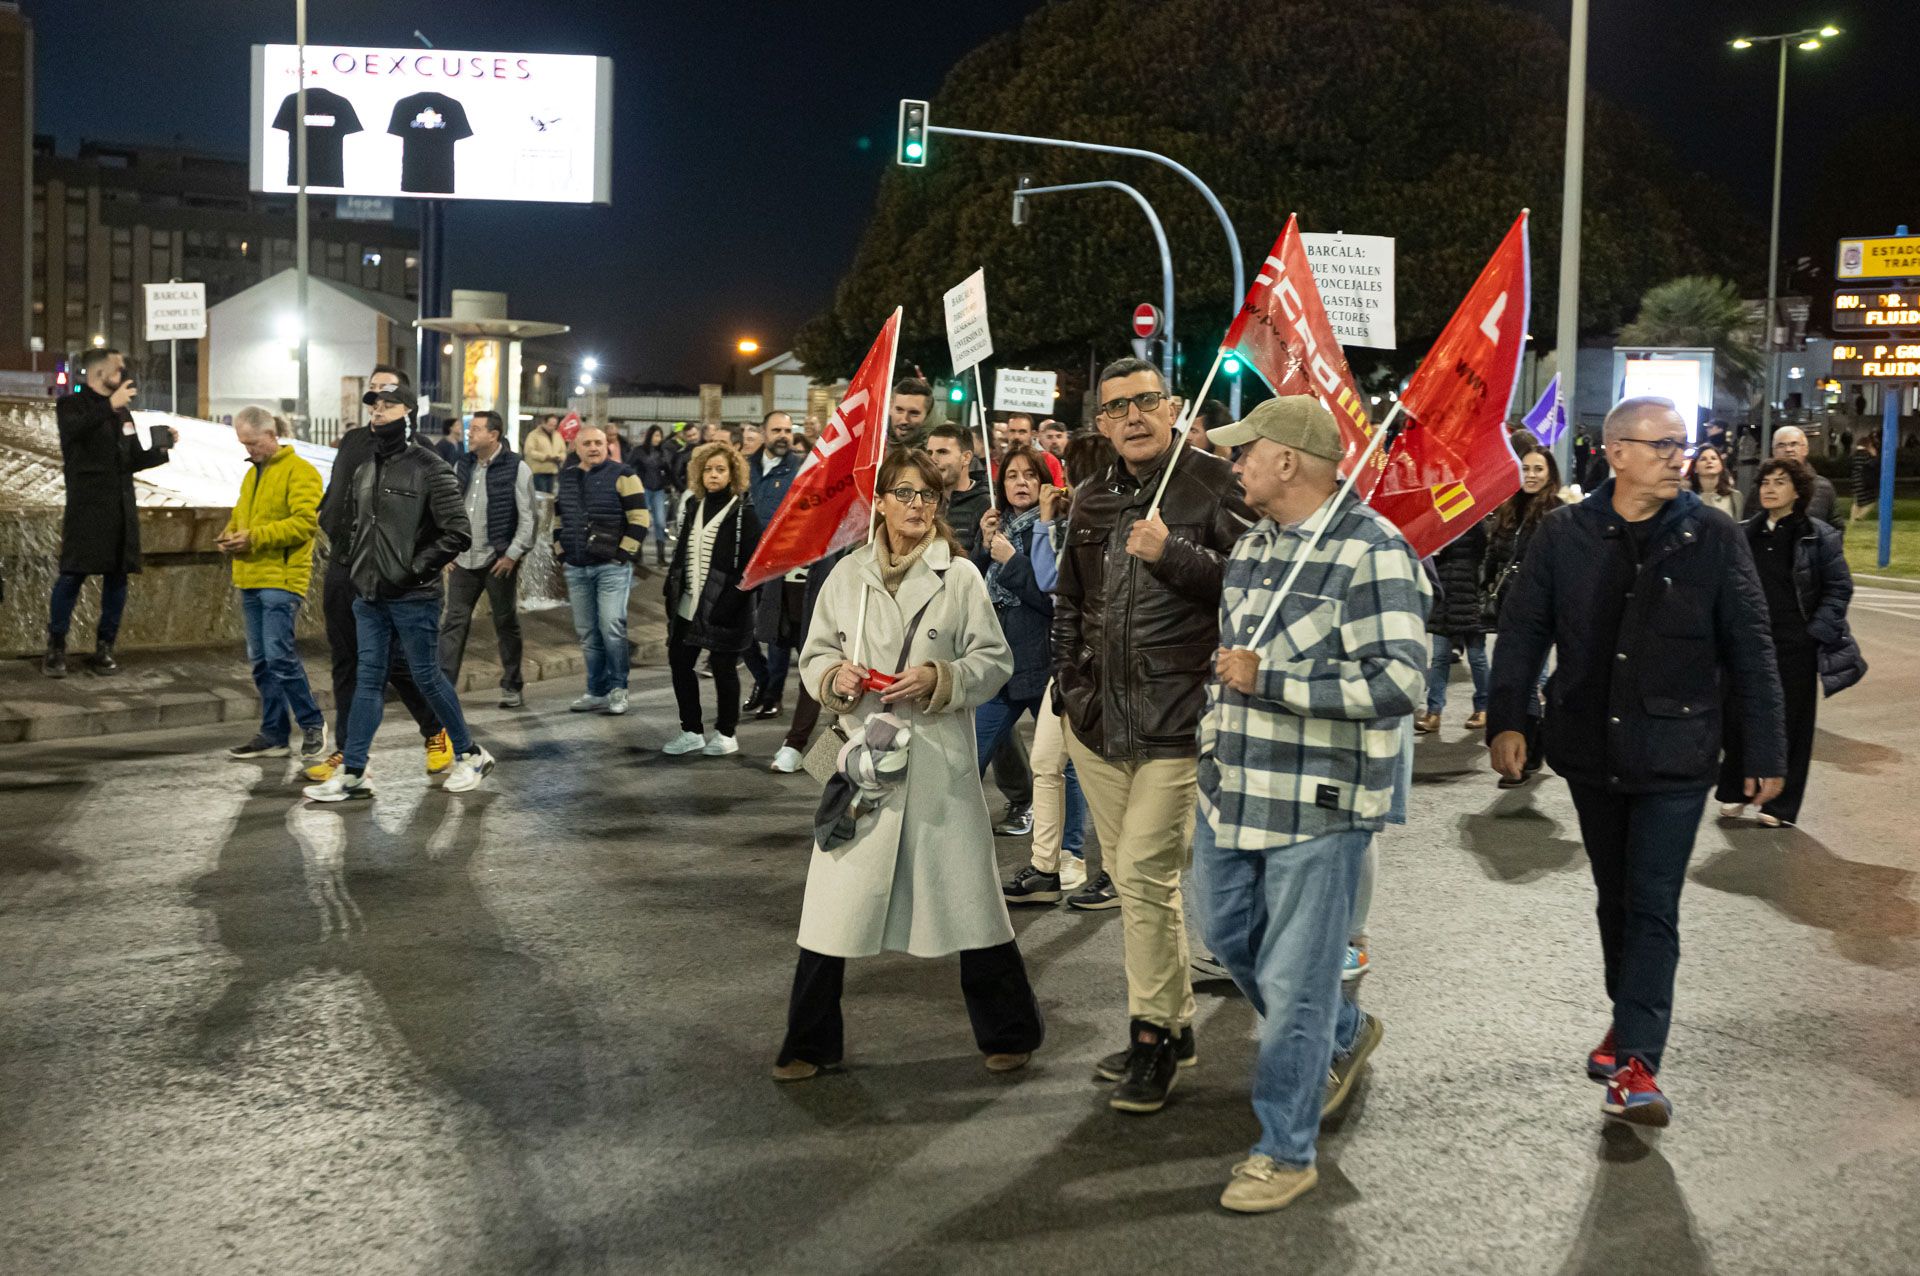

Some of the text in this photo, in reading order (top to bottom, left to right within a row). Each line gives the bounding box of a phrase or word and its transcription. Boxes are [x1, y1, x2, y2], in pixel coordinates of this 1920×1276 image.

[1307, 245, 1366, 258] BARCALA:
[1884, 257, 1920, 268] TRAF
[1331, 264, 1346, 274] NO
[1348, 265, 1381, 276] VALEN
[1314, 278, 1383, 292] CONCEJALES
[1322, 295, 1379, 308] GASTAS EN
[1836, 293, 1908, 309] AV. DR.
[1326, 310, 1370, 324] ECTORES
[1332, 325, 1369, 338] ERALES
[1833, 346, 1864, 360] AV.
[1003, 374, 1047, 384] BARCALA
[1003, 386, 1047, 397] NO TIENE
